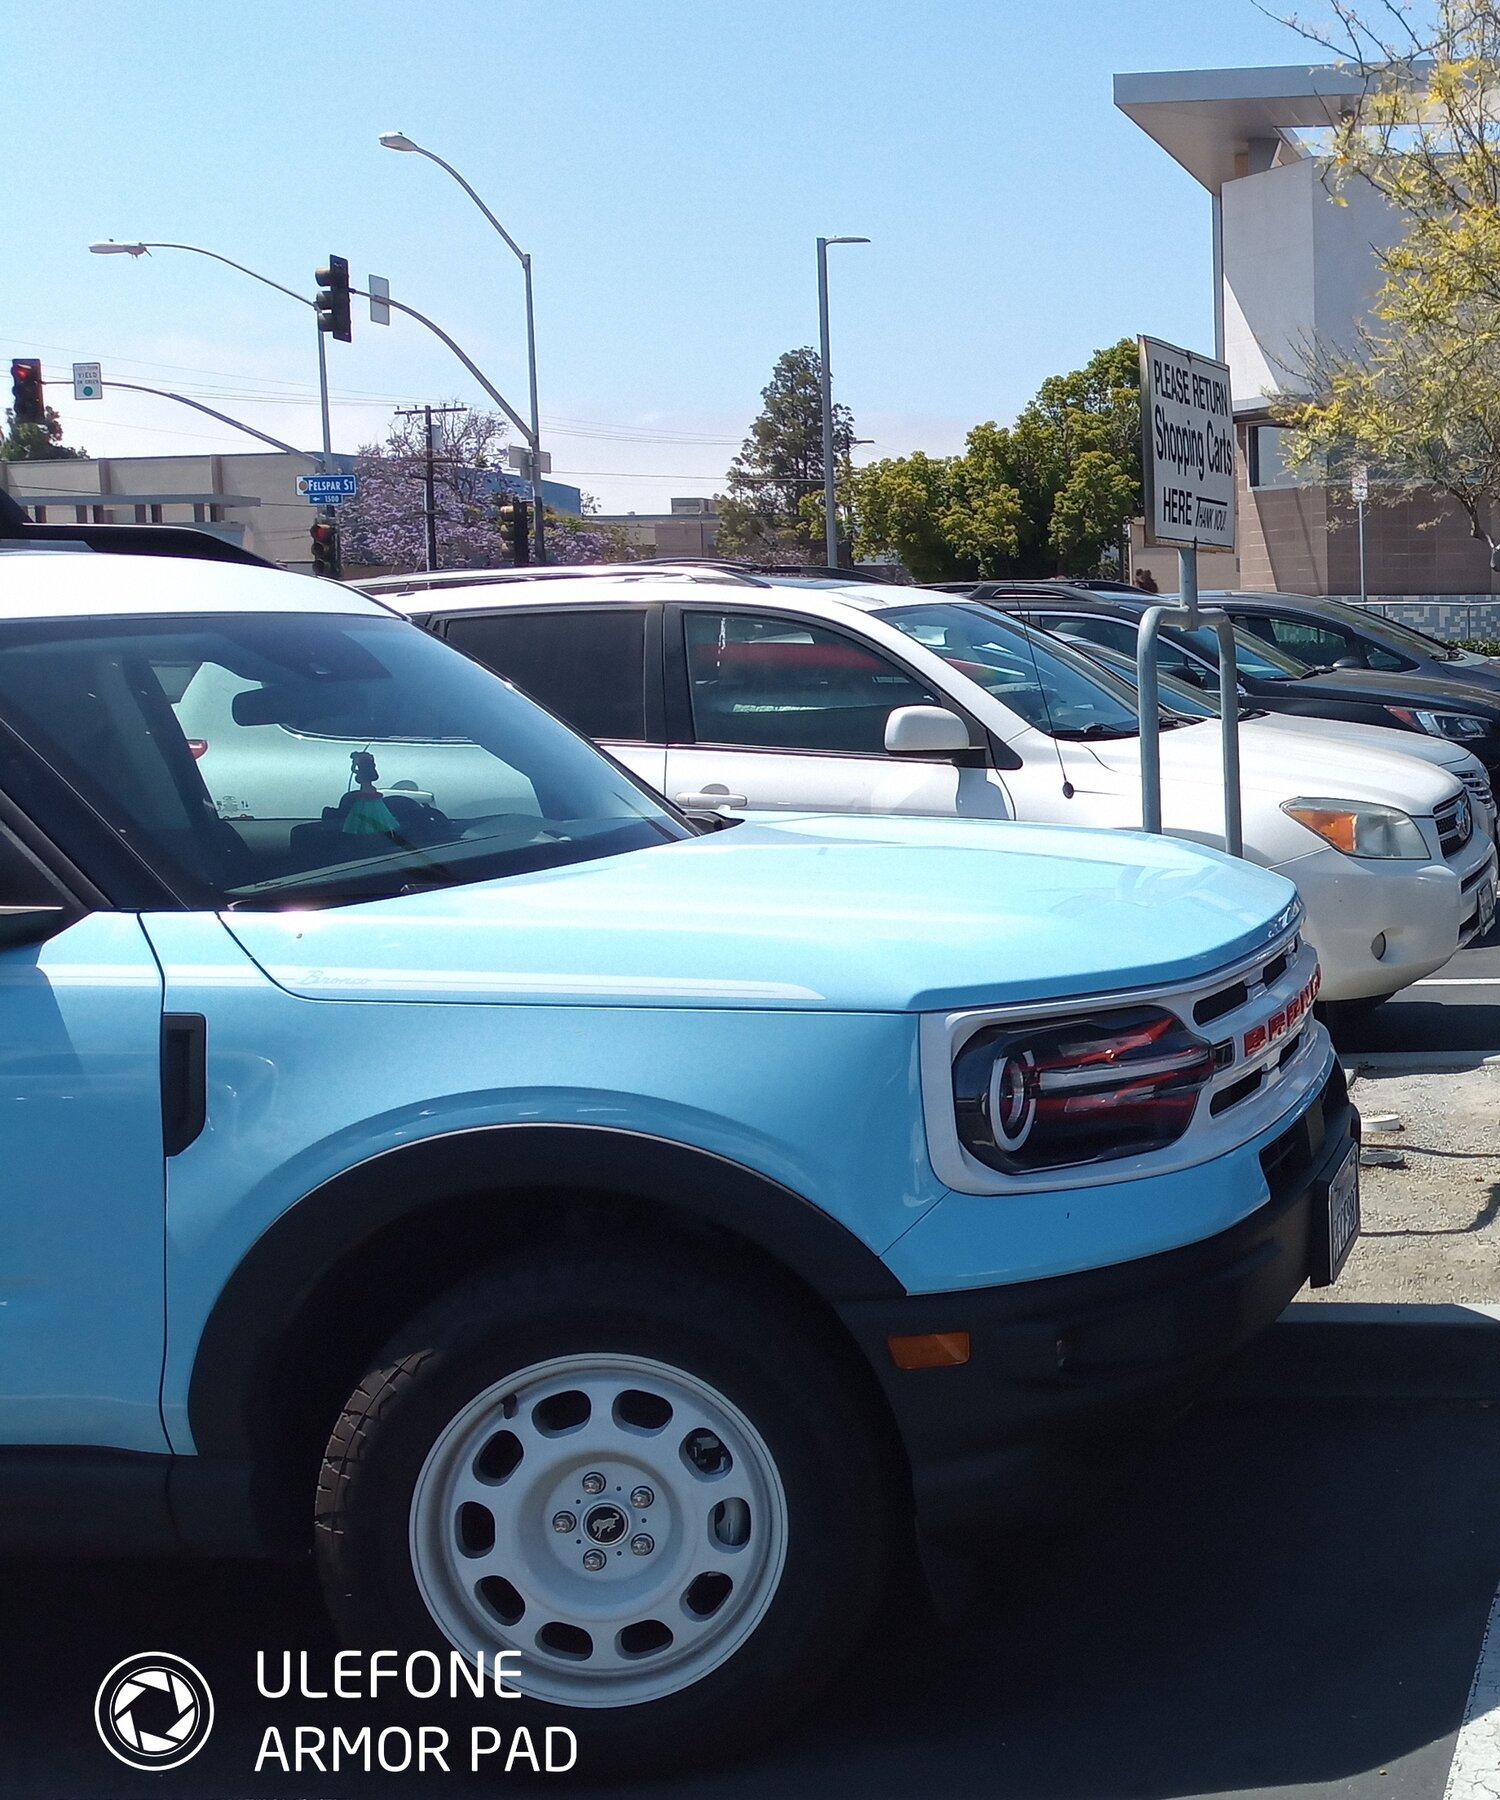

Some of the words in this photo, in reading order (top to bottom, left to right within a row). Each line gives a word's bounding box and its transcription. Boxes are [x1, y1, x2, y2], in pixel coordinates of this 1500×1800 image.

[1153, 359, 1191, 405] PLEASE
[1193, 374, 1228, 417] RETURN
[1154, 403, 1204, 481] Shopping
[1206, 420, 1232, 476] Carts
[1163, 486, 1192, 526] HERE
